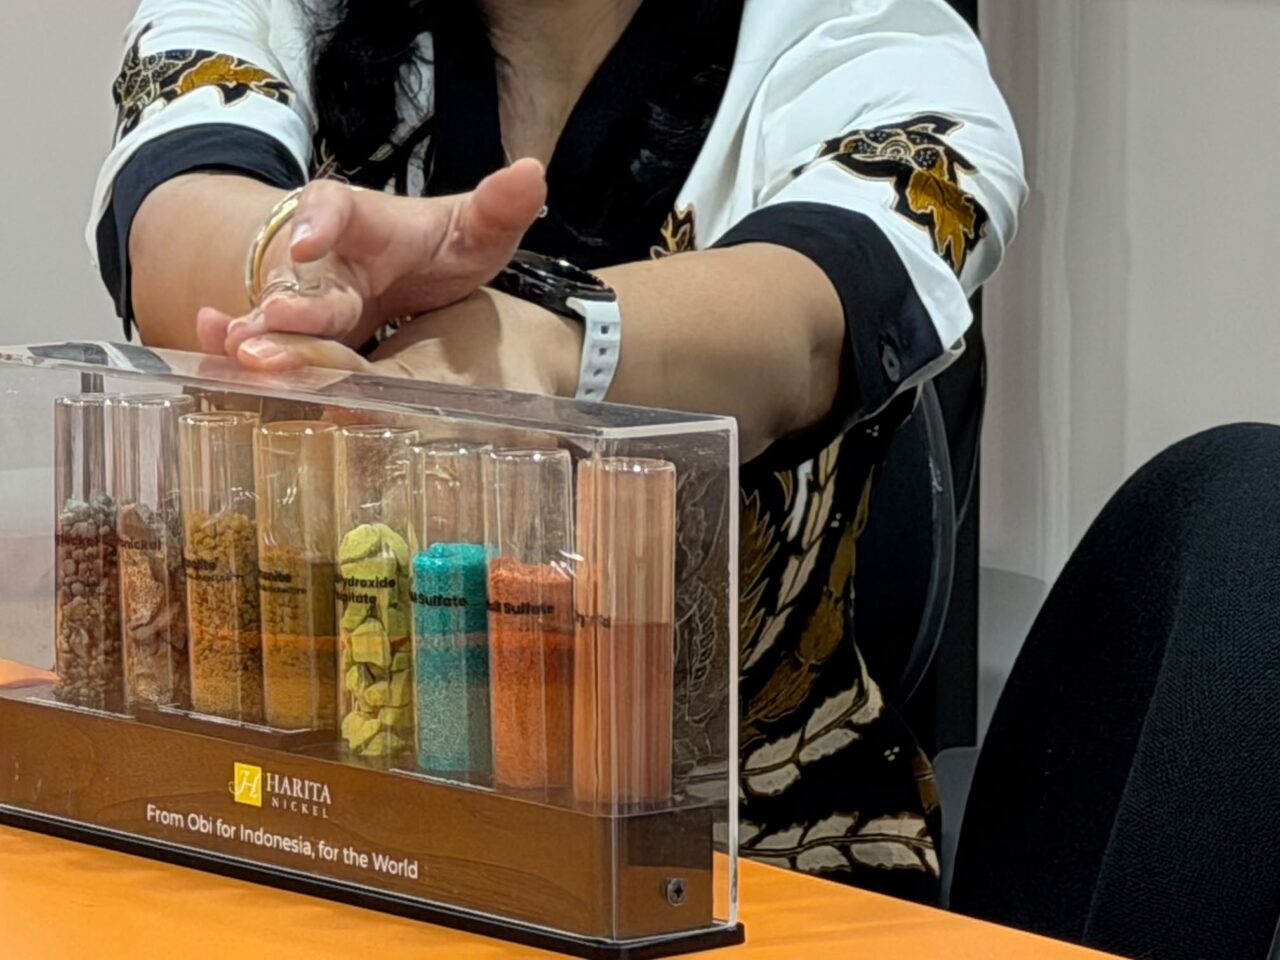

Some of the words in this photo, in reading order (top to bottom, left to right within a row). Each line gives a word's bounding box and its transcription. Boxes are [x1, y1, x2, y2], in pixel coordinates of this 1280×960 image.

[266, 772, 332, 805] HARITA
[271, 797, 329, 819] NICKEL
[147, 803, 184, 829] From
[187, 812, 213, 835] Obi
[216, 818, 235, 839] for
[240, 823, 315, 859] Indonesia,
[318, 840, 338, 862] for
[343, 846, 369, 868] the
[372, 852, 419, 880] World
